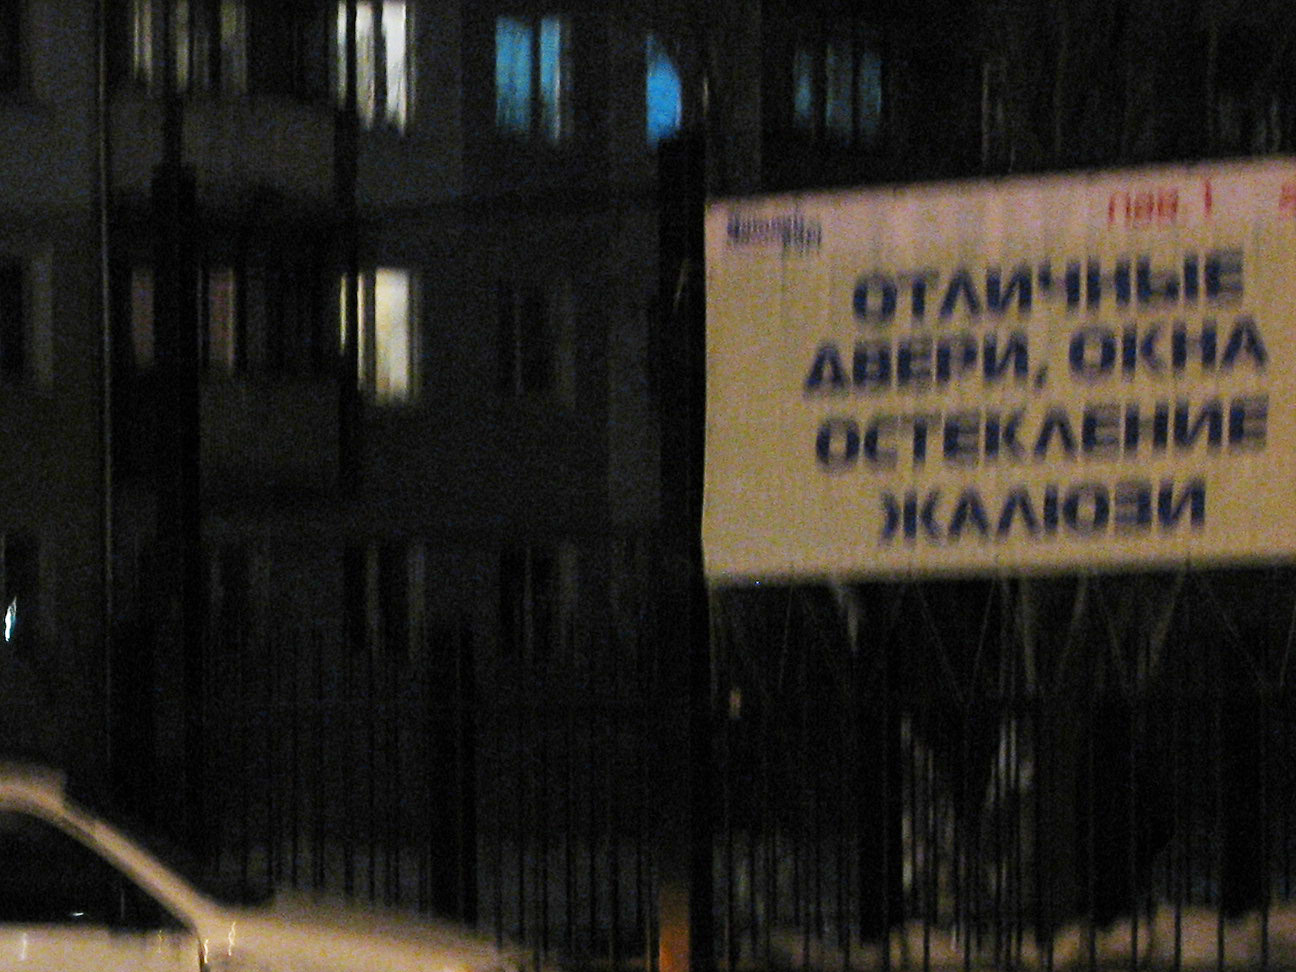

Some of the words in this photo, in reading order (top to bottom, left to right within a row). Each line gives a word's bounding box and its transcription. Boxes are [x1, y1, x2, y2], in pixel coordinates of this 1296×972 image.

[851, 247, 1244, 326] ОТЛИЧНЫЕ
[803, 330, 1050, 394] ДВЕРИ,
[1068, 313, 1270, 380] ОКНА
[815, 394, 1270, 472] ОСТЕКЛЕНИЕ
[879, 476, 1207, 545] ЖАЛЮЗИ
